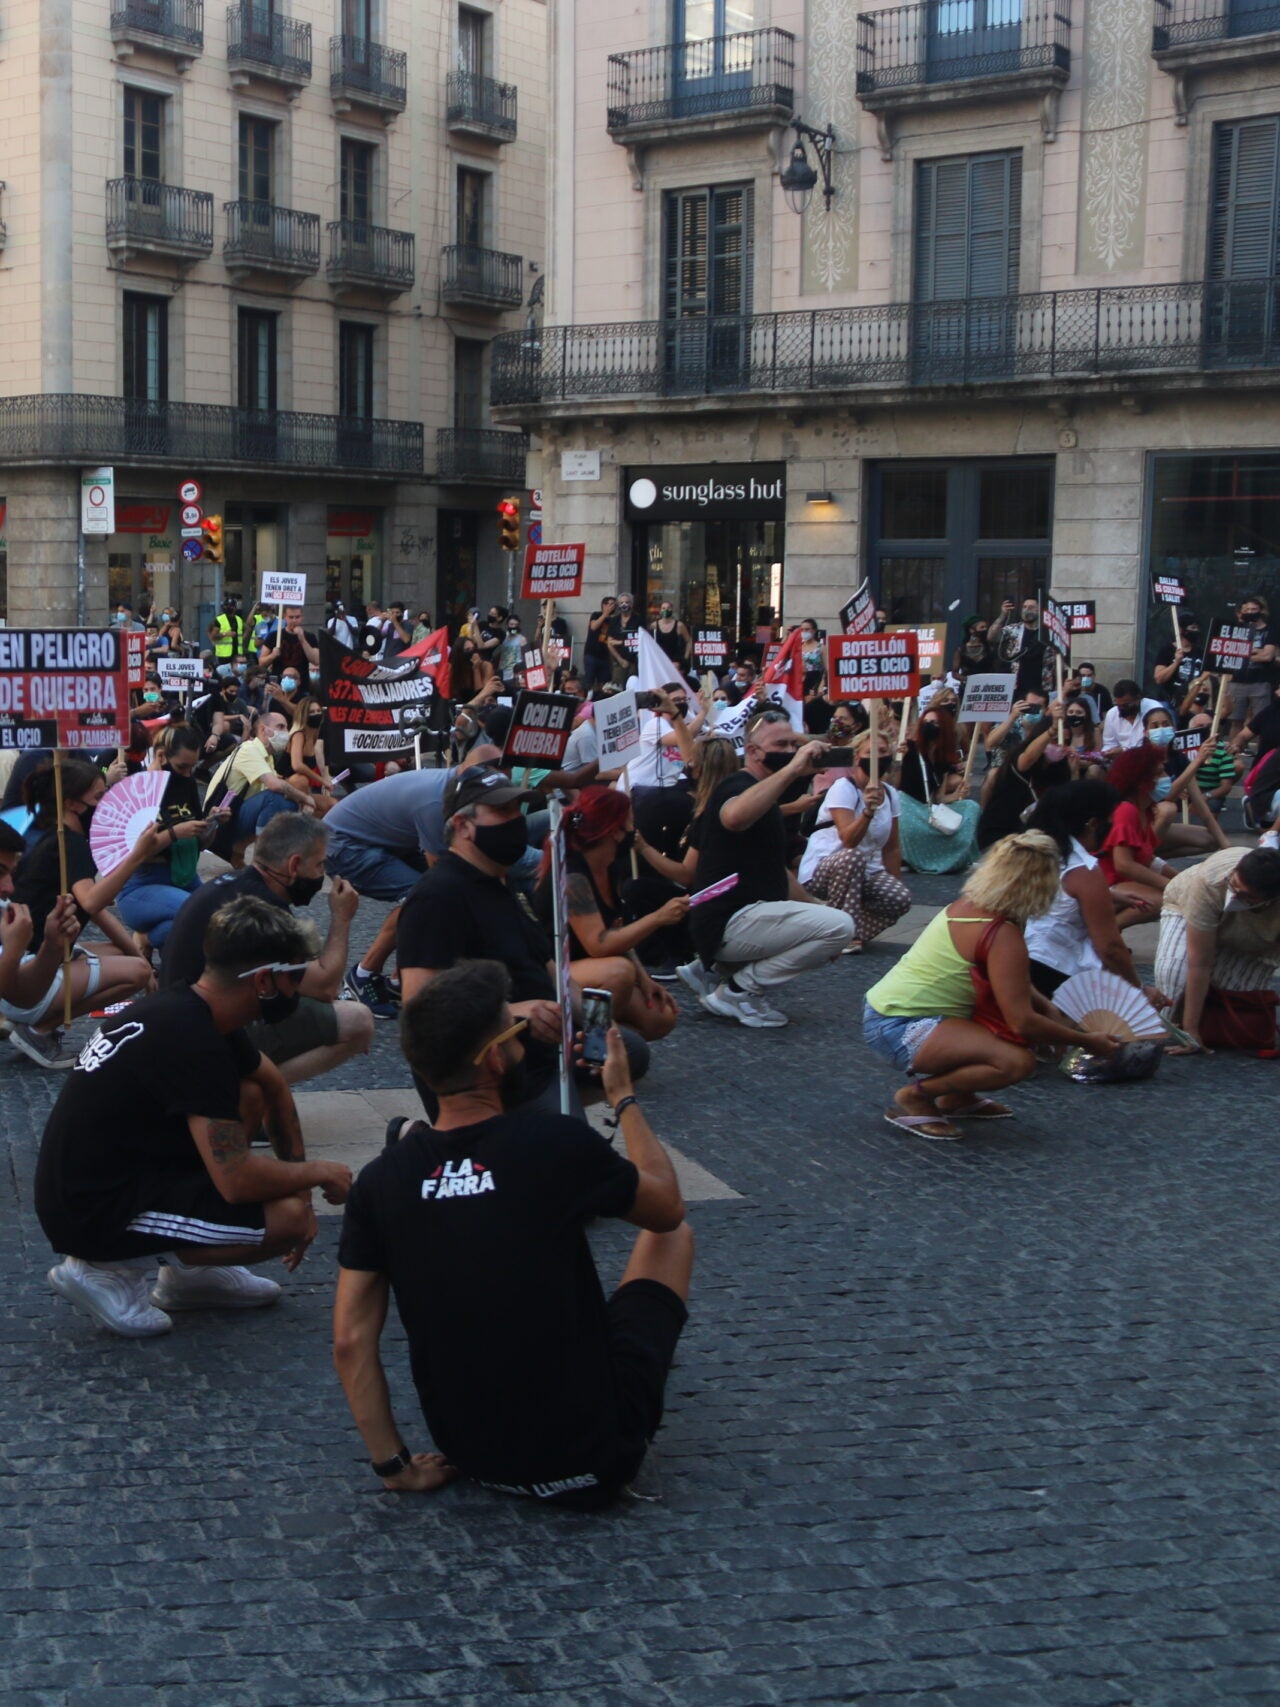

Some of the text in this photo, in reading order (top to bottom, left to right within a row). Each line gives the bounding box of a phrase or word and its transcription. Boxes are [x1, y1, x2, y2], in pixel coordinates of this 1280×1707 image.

[662, 478, 784, 506] sunglass hut
[536, 546, 578, 563] BOTELLÓN
[531, 563, 577, 578] NO ES OCIO
[531, 578, 574, 593] NOCTURNO
[1073, 604, 1087, 616] EN
[698, 631, 721, 641] EL BAILE
[1220, 625, 1250, 640] EL BAILE
[31, 632, 115, 668] PELIGRO
[694, 643, 726, 654] ES CULTURA
[842, 636, 906, 657] BOTELLÓN
[1211, 639, 1250, 656] ES CULTURA
[704, 655, 722, 666] SALUD
[839, 660, 858, 675] NO
[861, 659, 878, 674] ES
[880, 657, 910, 673] OCIO
[1216, 654, 1243, 669] Y SALUD
[841, 675, 909, 693] NOCTURNO
[30, 675, 117, 714] QUIEBRA
[522, 702, 568, 729] OCIO EN
[607, 712, 617, 725] LOS
[2, 728, 41, 747] EL OCIO
[67, 727, 121, 746] YO TAMBIÉN
[513, 729, 561, 756] QUIEBRA
[1187, 733, 1200, 748] EN
[442, 1158, 473, 1178] LA
[421, 1170, 495, 1200] FARRA
